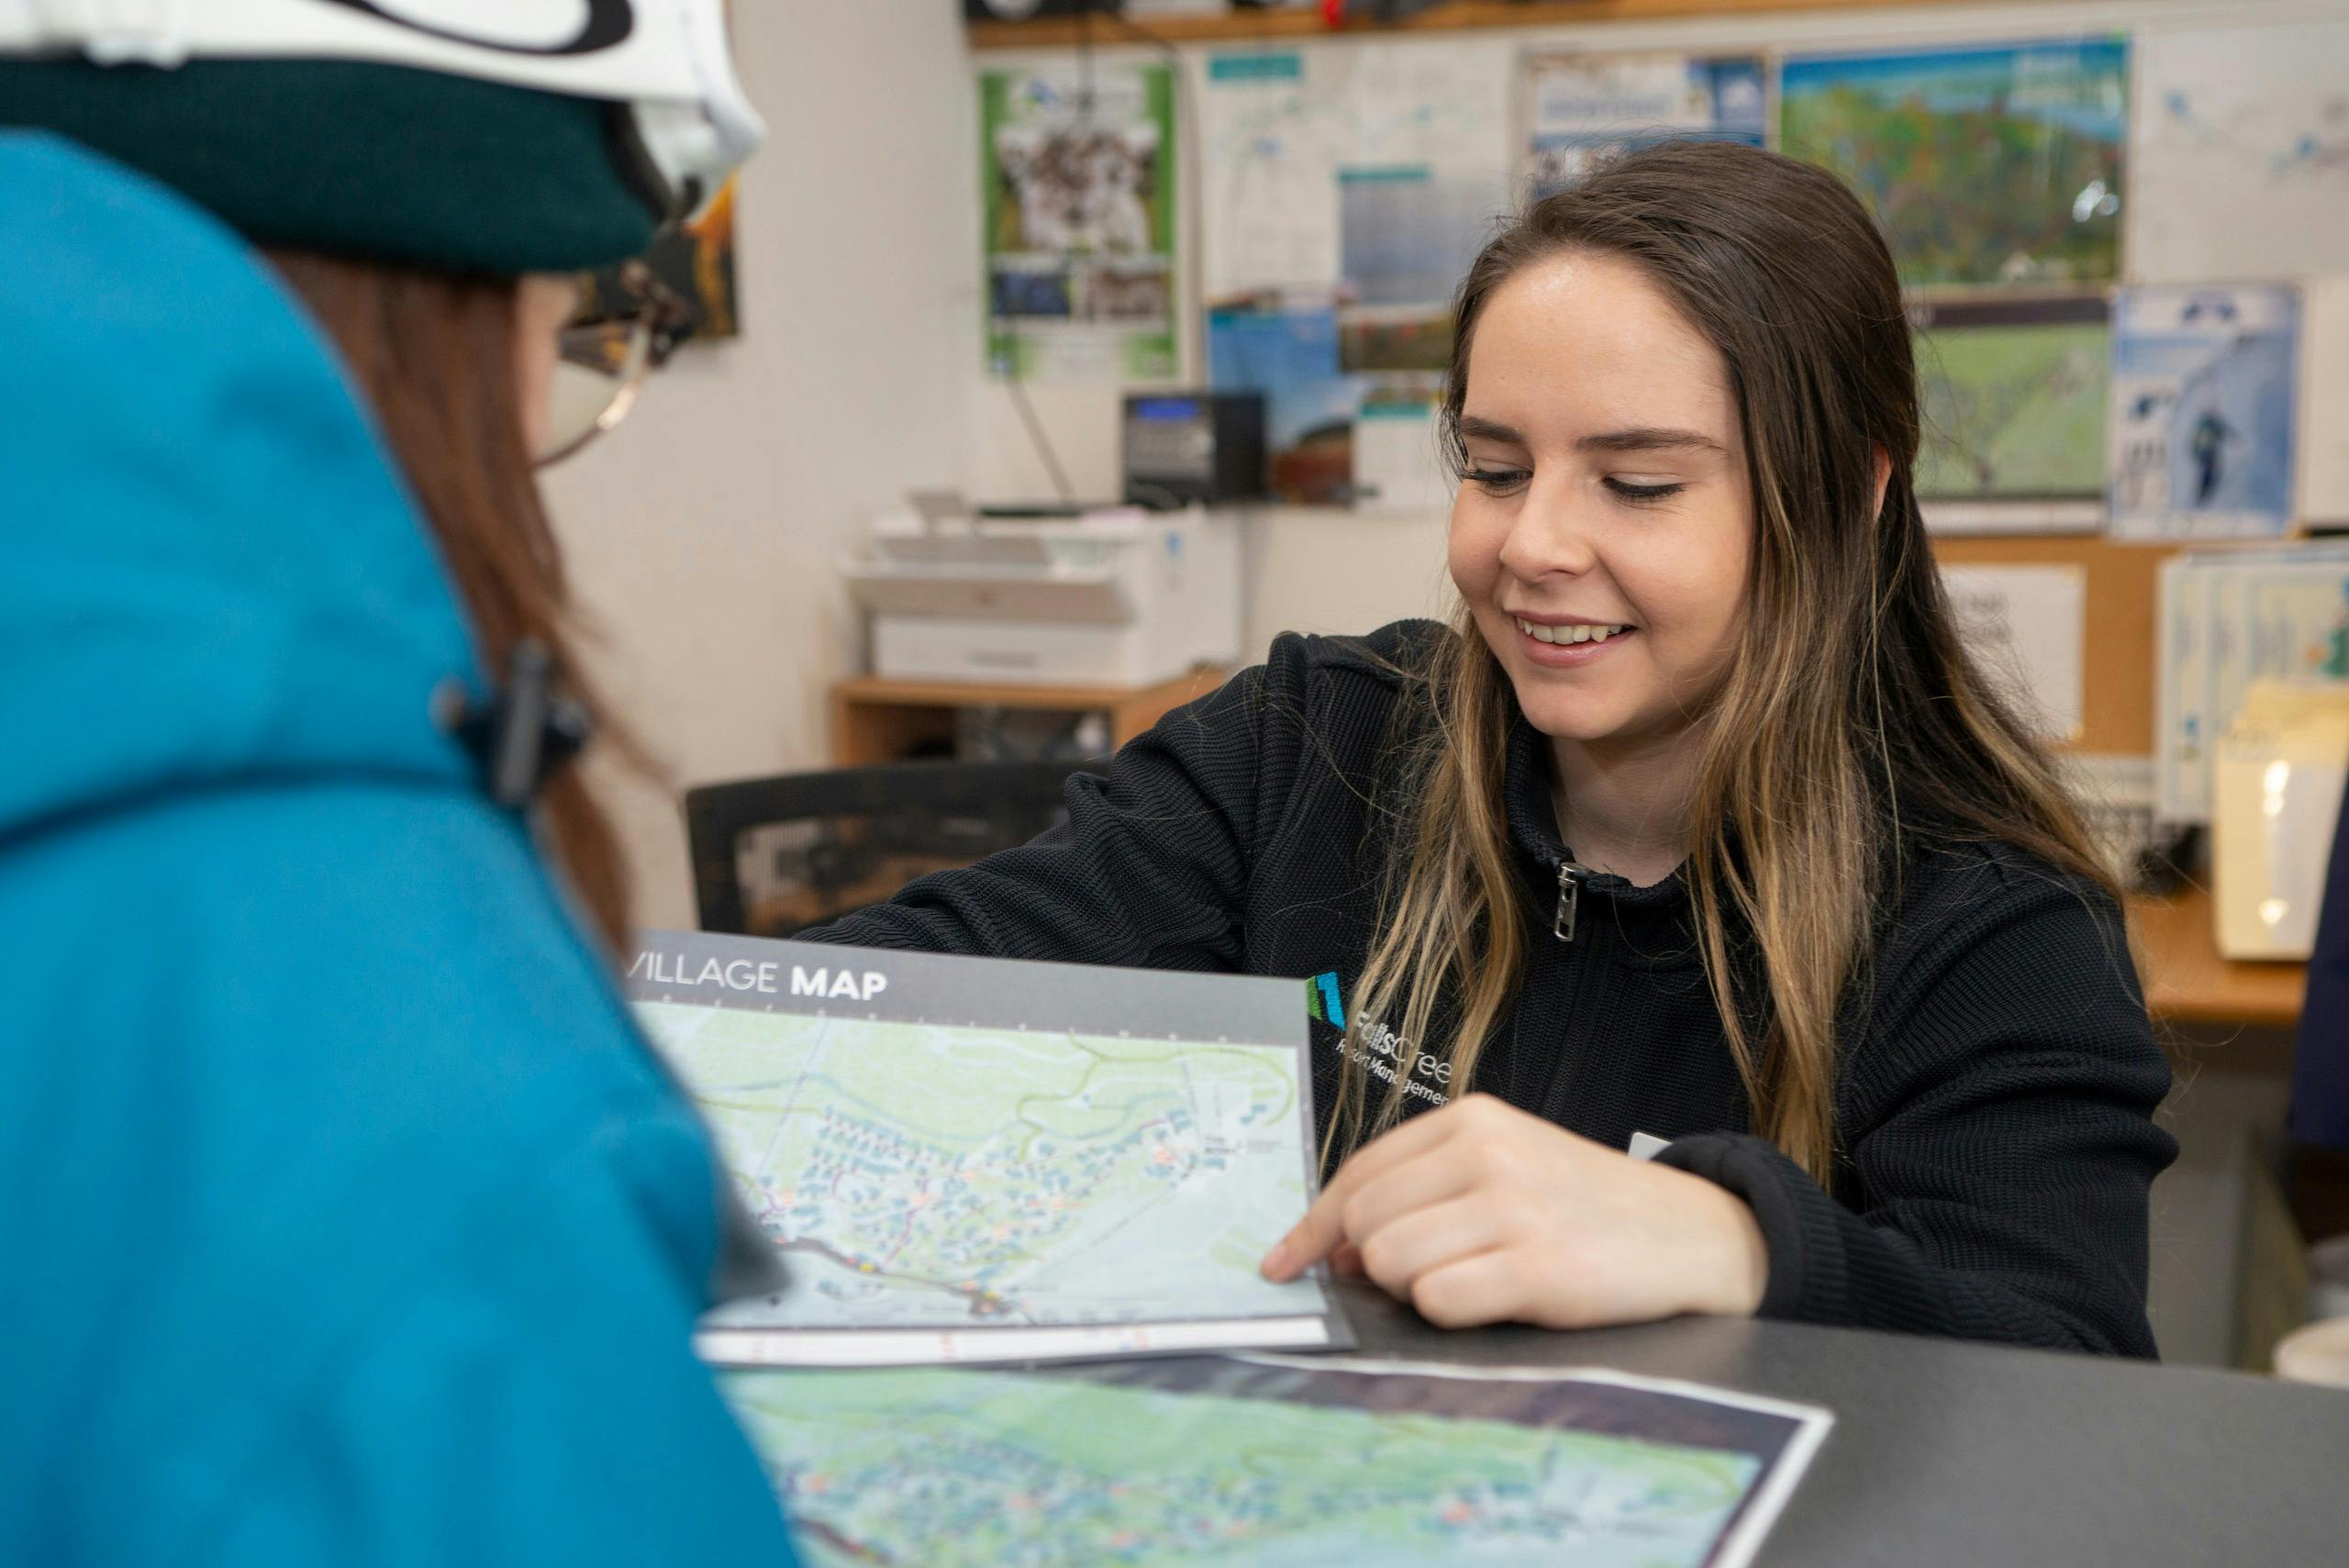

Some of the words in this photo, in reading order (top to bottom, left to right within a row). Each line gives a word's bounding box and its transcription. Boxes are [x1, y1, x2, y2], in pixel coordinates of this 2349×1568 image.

[626, 951, 779, 994] VILLAGE
[790, 965, 888, 1001] MAP
[1335, 1038, 1370, 1068] Rsort
[1367, 1056, 1451, 1106] Mangemen
[1356, 1009, 1452, 1084] FallsCee
